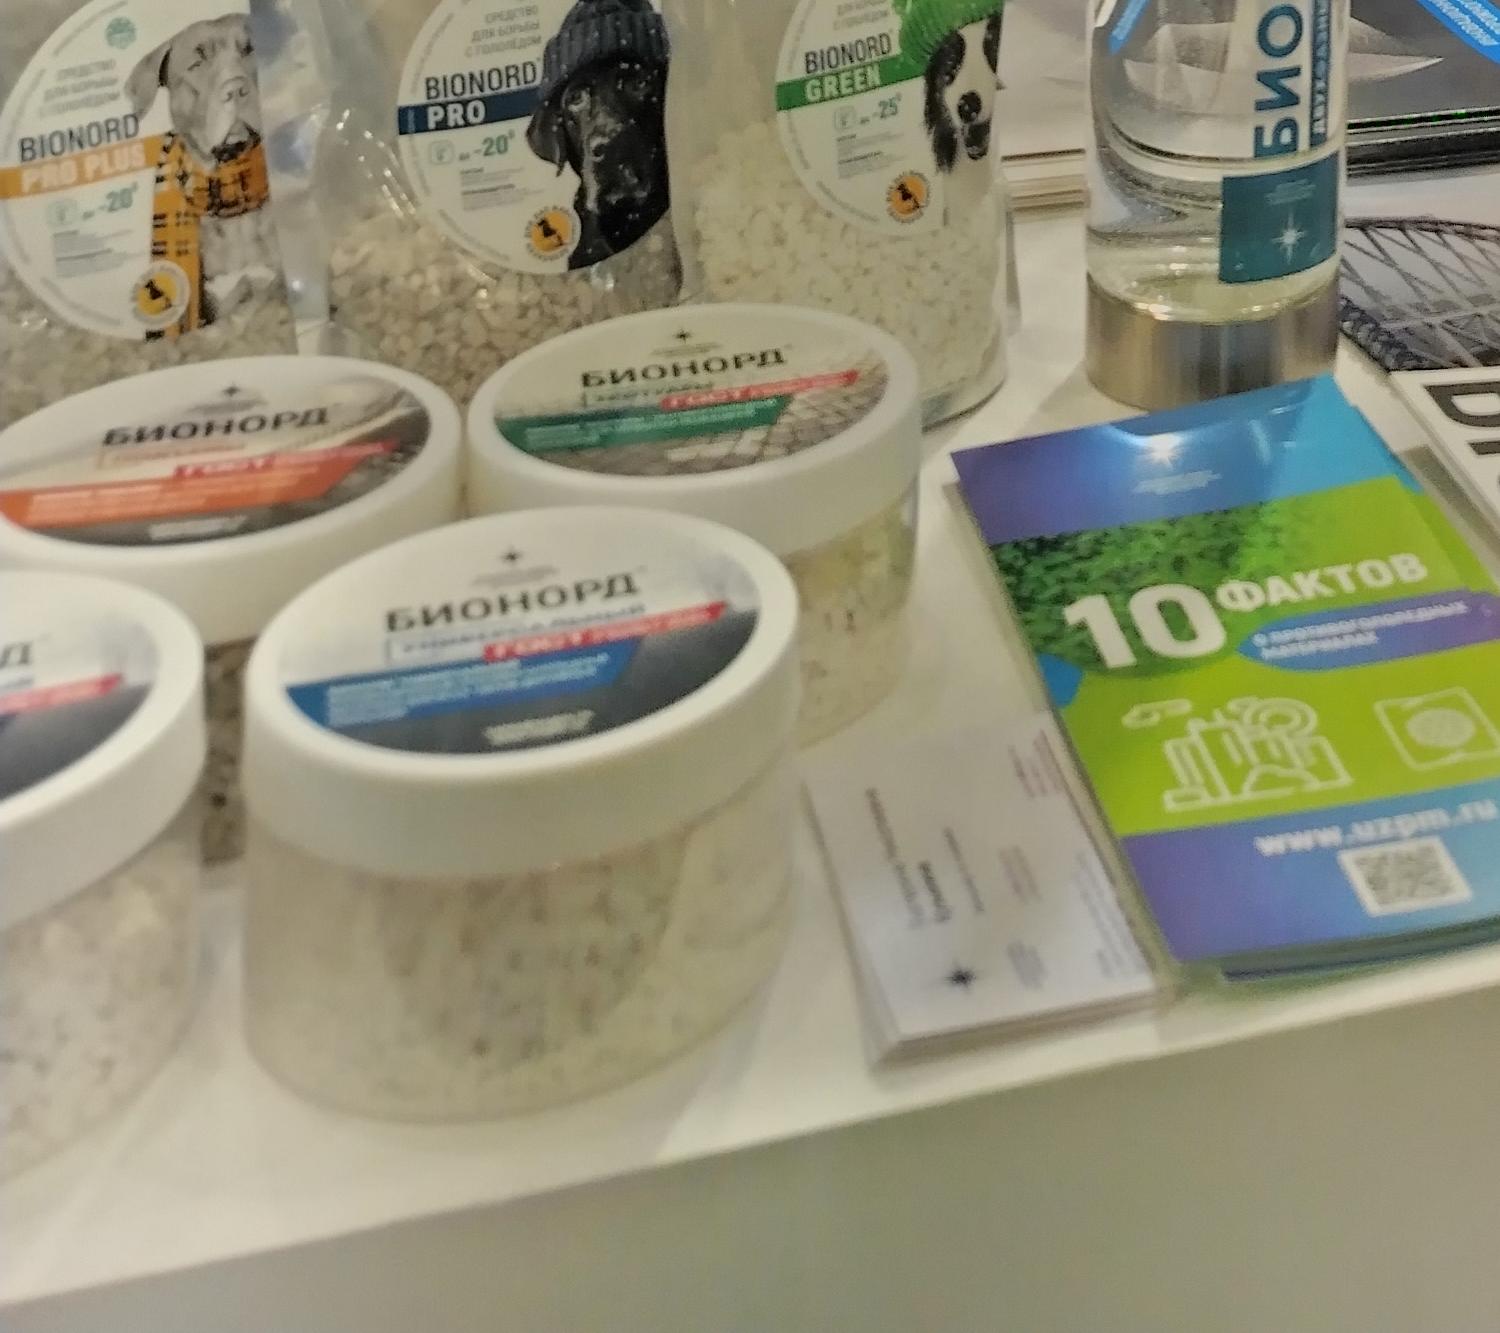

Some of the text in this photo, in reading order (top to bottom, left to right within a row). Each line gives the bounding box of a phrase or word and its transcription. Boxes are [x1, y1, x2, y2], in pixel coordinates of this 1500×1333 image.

[804, 32, 892, 74] BIONORD
[425, 61, 537, 100] BIONORD
[804, 64, 881, 102] GREEN
[427, 100, 486, 130] PRO
[20, 113, 140, 162] BIONORD
[21, 142, 146, 194] PRO PLUS
[582, 347, 787, 388] БИОНОРД
[102, 406, 332, 447] БИОНОРД
[386, 572, 642, 633] БИОНОРД
[1062, 552, 1429, 669] 10 ФАКТОВ
